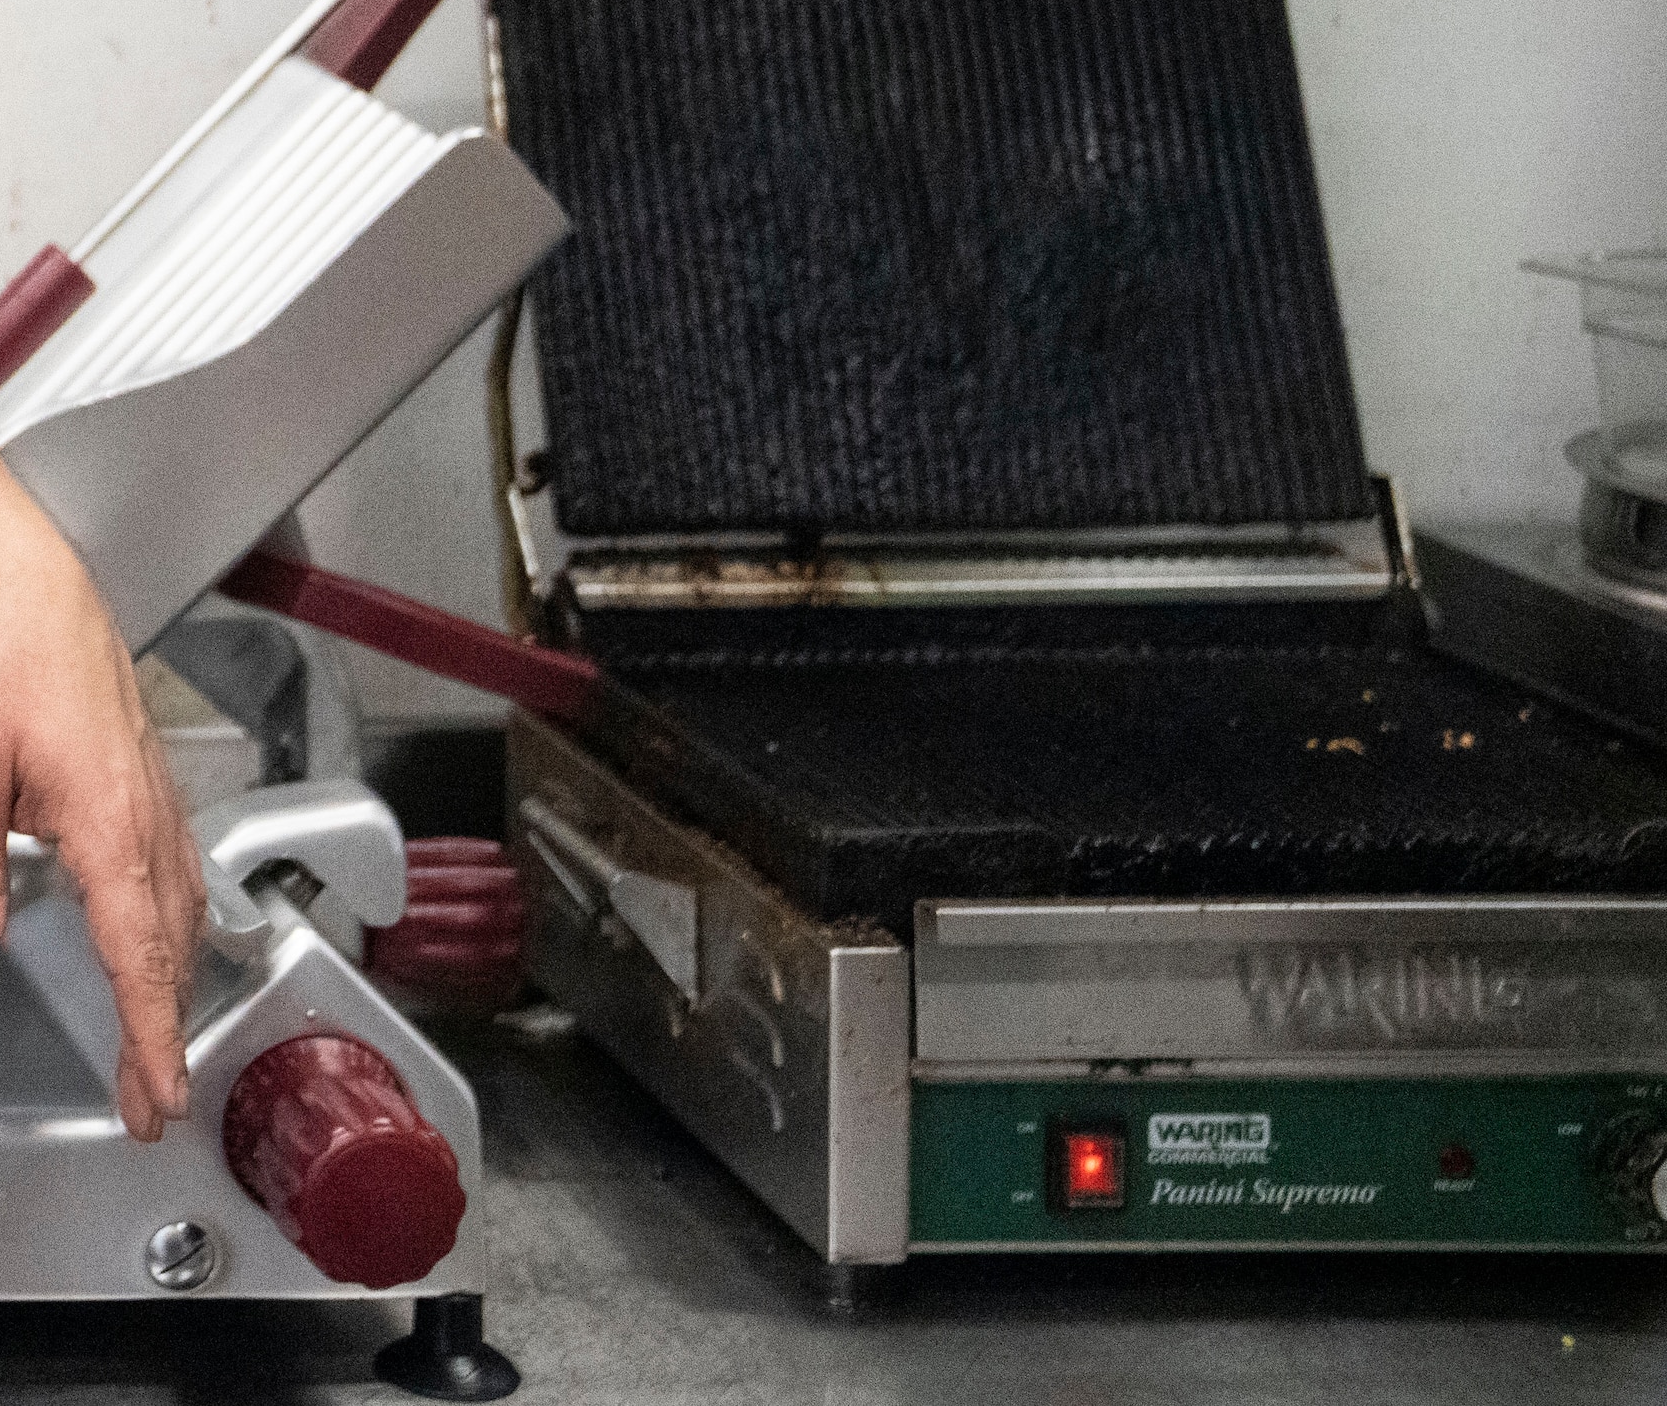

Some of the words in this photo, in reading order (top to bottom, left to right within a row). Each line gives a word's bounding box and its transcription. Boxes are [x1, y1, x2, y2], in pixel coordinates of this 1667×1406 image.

[1156, 1119, 1265, 1144] WARING
[1147, 1150, 1271, 1166] COMMERCIAL
[1149, 1177, 1245, 1205] Panini
[1250, 1175, 1381, 1214] Supremo
